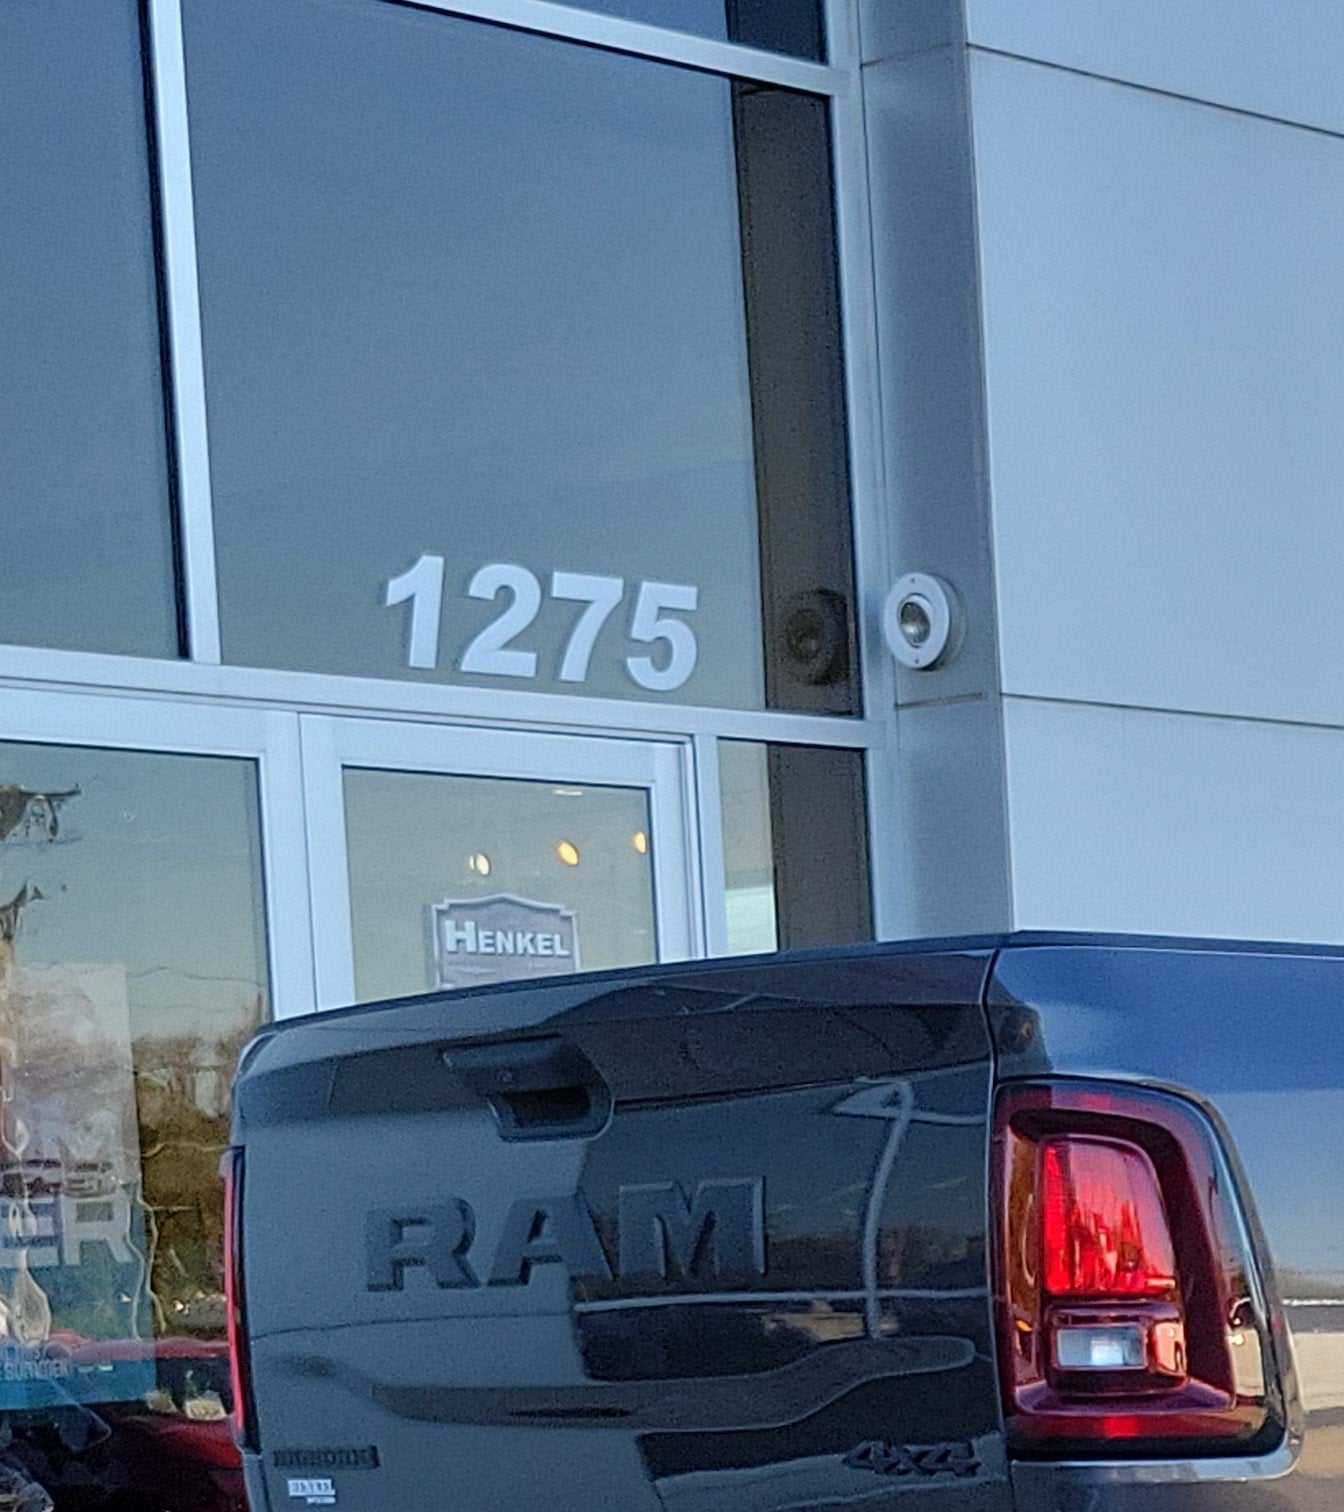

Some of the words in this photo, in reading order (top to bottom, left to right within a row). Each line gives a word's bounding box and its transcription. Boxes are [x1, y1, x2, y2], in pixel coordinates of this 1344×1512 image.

[386, 555, 698, 691] 1275
[444, 920, 570, 956] HENKEL
[366, 1176, 767, 1292] RAM
